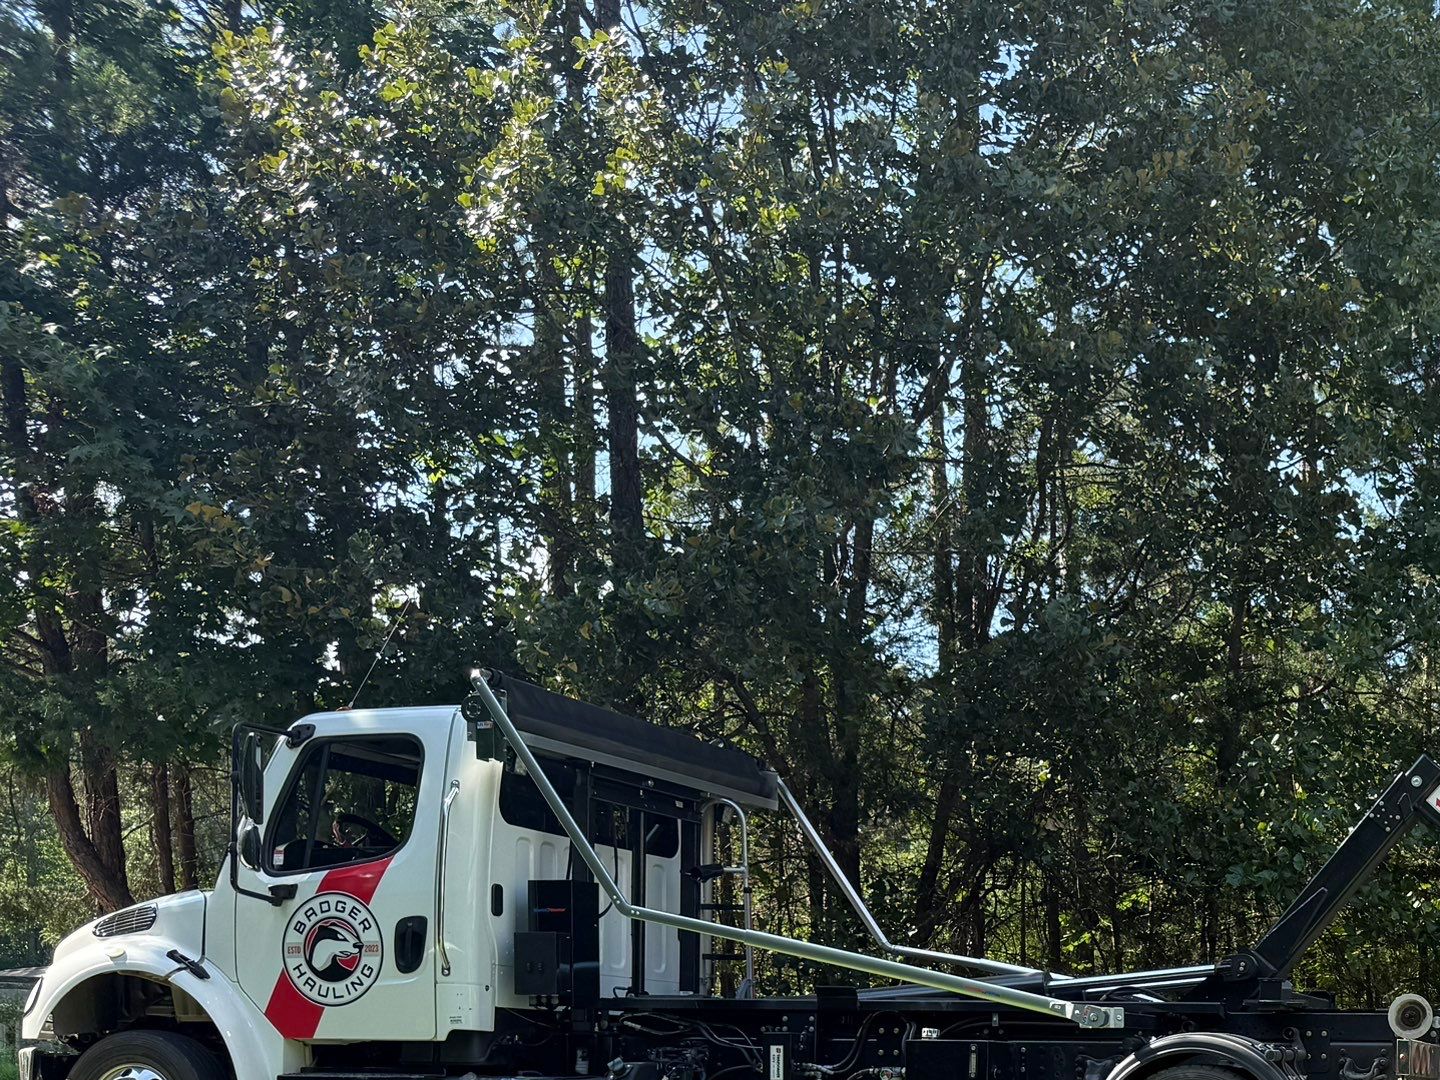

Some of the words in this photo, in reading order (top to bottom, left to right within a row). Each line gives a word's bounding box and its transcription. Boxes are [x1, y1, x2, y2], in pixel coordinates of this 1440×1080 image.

[294, 900, 372, 935] BADGER
[288, 946, 301, 954] ESTD
[293, 964, 374, 999] HAULING
